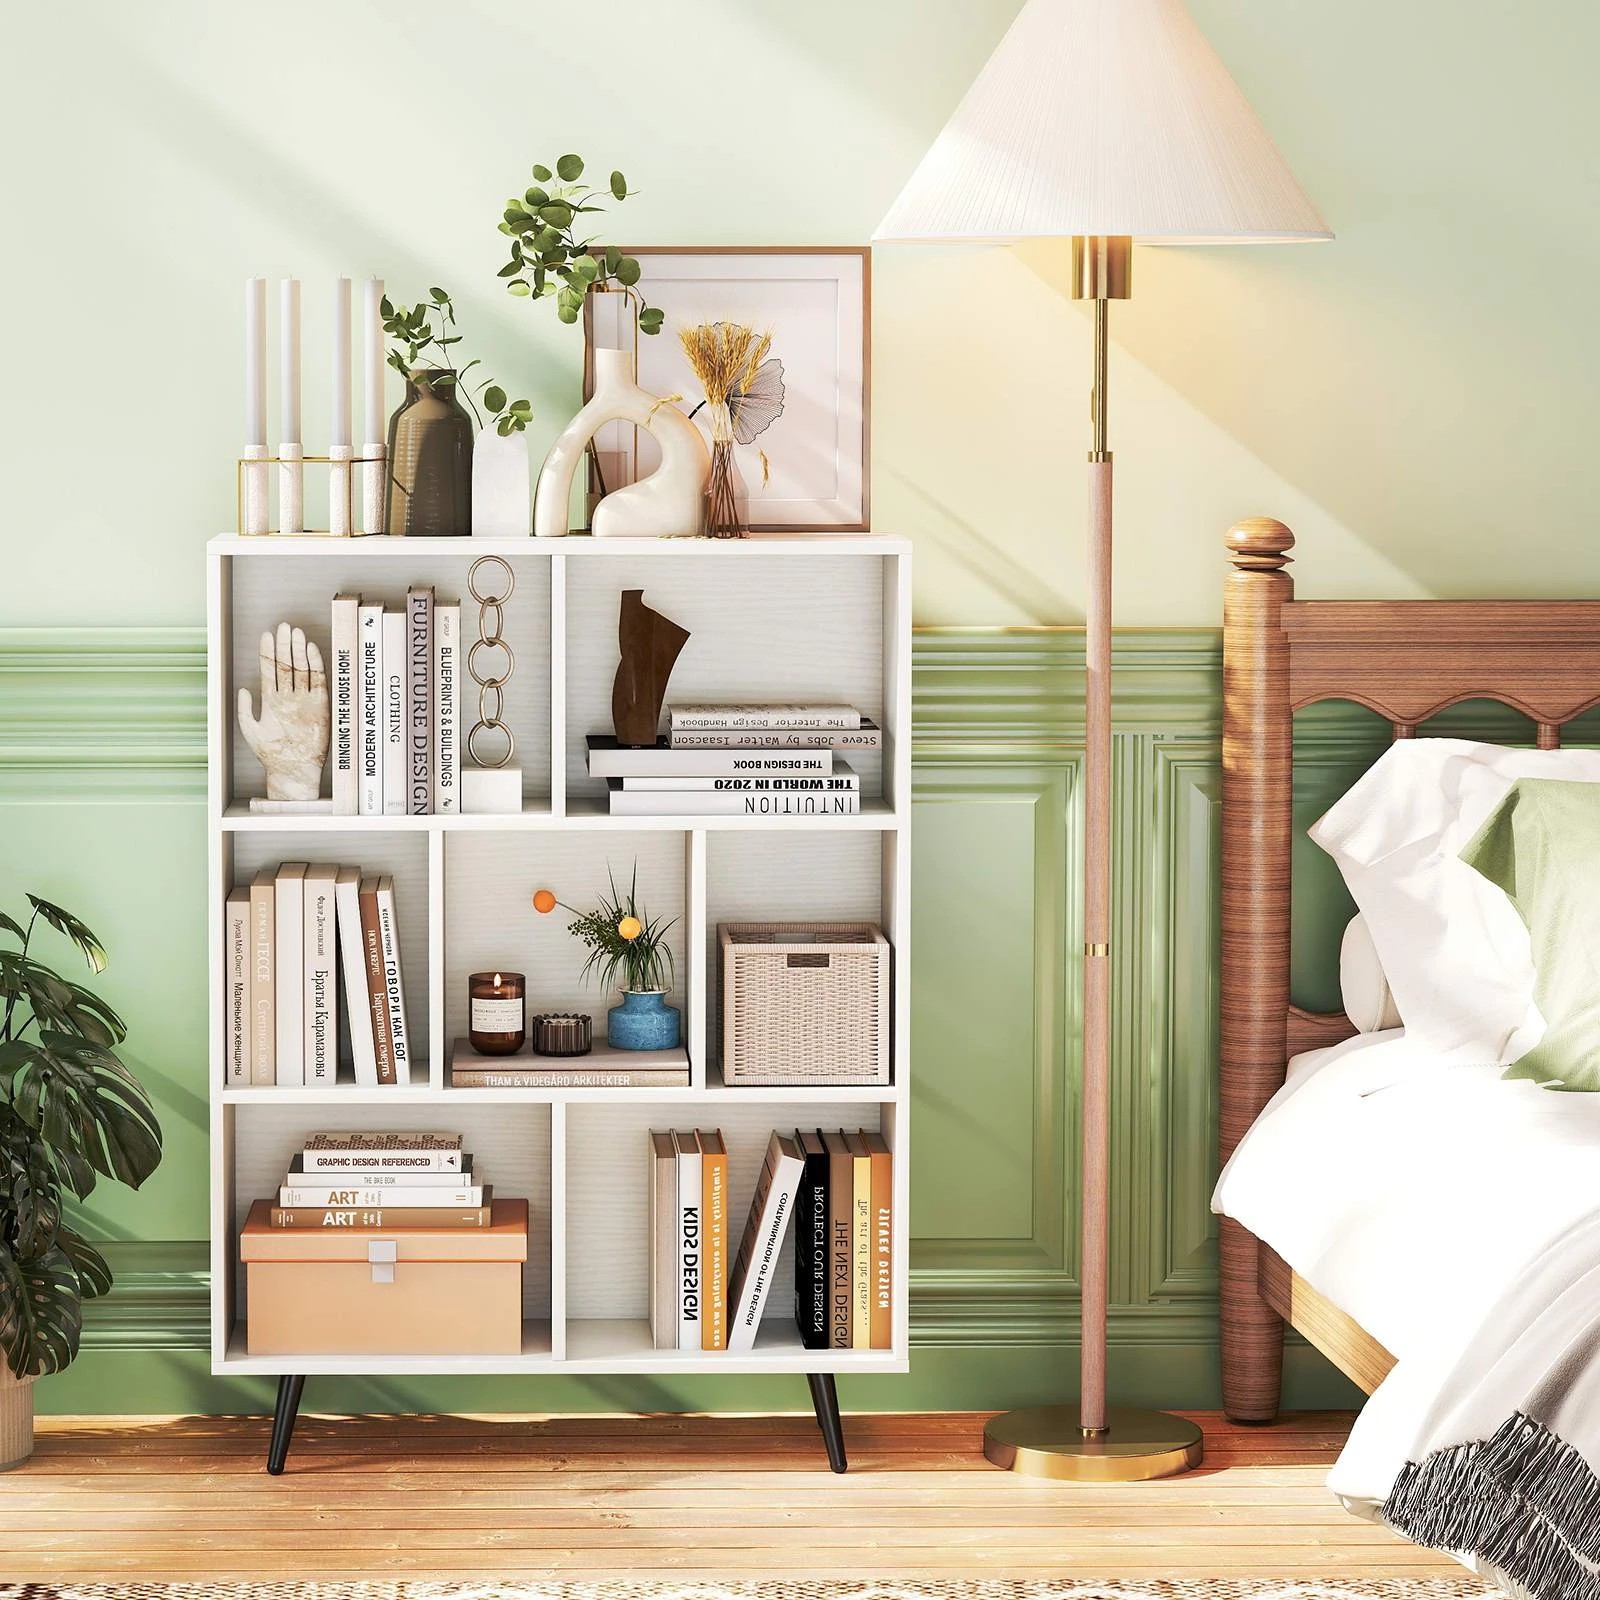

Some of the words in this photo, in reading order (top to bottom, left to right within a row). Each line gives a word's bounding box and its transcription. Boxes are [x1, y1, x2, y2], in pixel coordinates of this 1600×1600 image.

[338, 649, 350, 675] HOME
[412, 597, 428, 728] FURNITURE
[365, 642, 376, 726] ARCHITECTURE
[441, 647, 452, 715] BLUEPRINTS
[338, 676, 350, 706] HOUSE
[338, 708, 351, 725] THE
[390, 675, 401, 744] CLOTHING
[441, 718, 452, 726] &
[679, 718, 727, 728] Handbook
[732, 717, 769, 727] Design
[775, 718, 821, 727] Interior
[827, 718, 845, 727] The
[674, 735, 730, 745] Isaacson
[737, 735, 779, 745] Walter
[785, 734, 800, 745] by
[807, 735, 835, 745] Jobs
[842, 735, 877, 745] Steve
[338, 727, 351, 770] BRINGING
[365, 729, 376, 777] MODERN
[441, 728, 452, 787] BUILDINGS
[733, 760, 762, 769] BOOK
[763, 760, 802, 769] DESIGN
[803, 760, 823, 769] THE
[412, 735, 428, 815] DESIGN
[714, 779, 752, 790] 2020
[755, 779, 770, 790] IN
[773, 779, 825, 790] WORLD
[827, 779, 853, 790] THE
[745, 796, 853, 814] INTUITION
[257, 942, 269, 983] ГЕССЕ
[312, 970, 329, 1008] Братья
[385, 960, 399, 1014] ГОВОРИ
[234, 982, 244, 1032] Маленькие
[372, 992, 388, 1043] Бархатная
[391, 1016, 403, 1038] КАК
[312, 1011, 329, 1078] Карамазовы
[394, 1042, 406, 1062] БОГ
[233, 1033, 243, 1076] женщины
[377, 1044, 389, 1077] смерть
[484, 1075, 512, 1086] THAM
[513, 1075, 522, 1086] &
[524, 1073, 570, 1086] VIDEGÅRD
[573, 1074, 630, 1086] ARKITEKTER
[316, 1158, 351, 1167] GRAPHIC
[352, 1158, 380, 1167] DESIGN
[381, 1158, 431, 1167] REFERENCED
[327, 1191, 359, 1204] ART
[322, 1212, 357, 1226] ART
